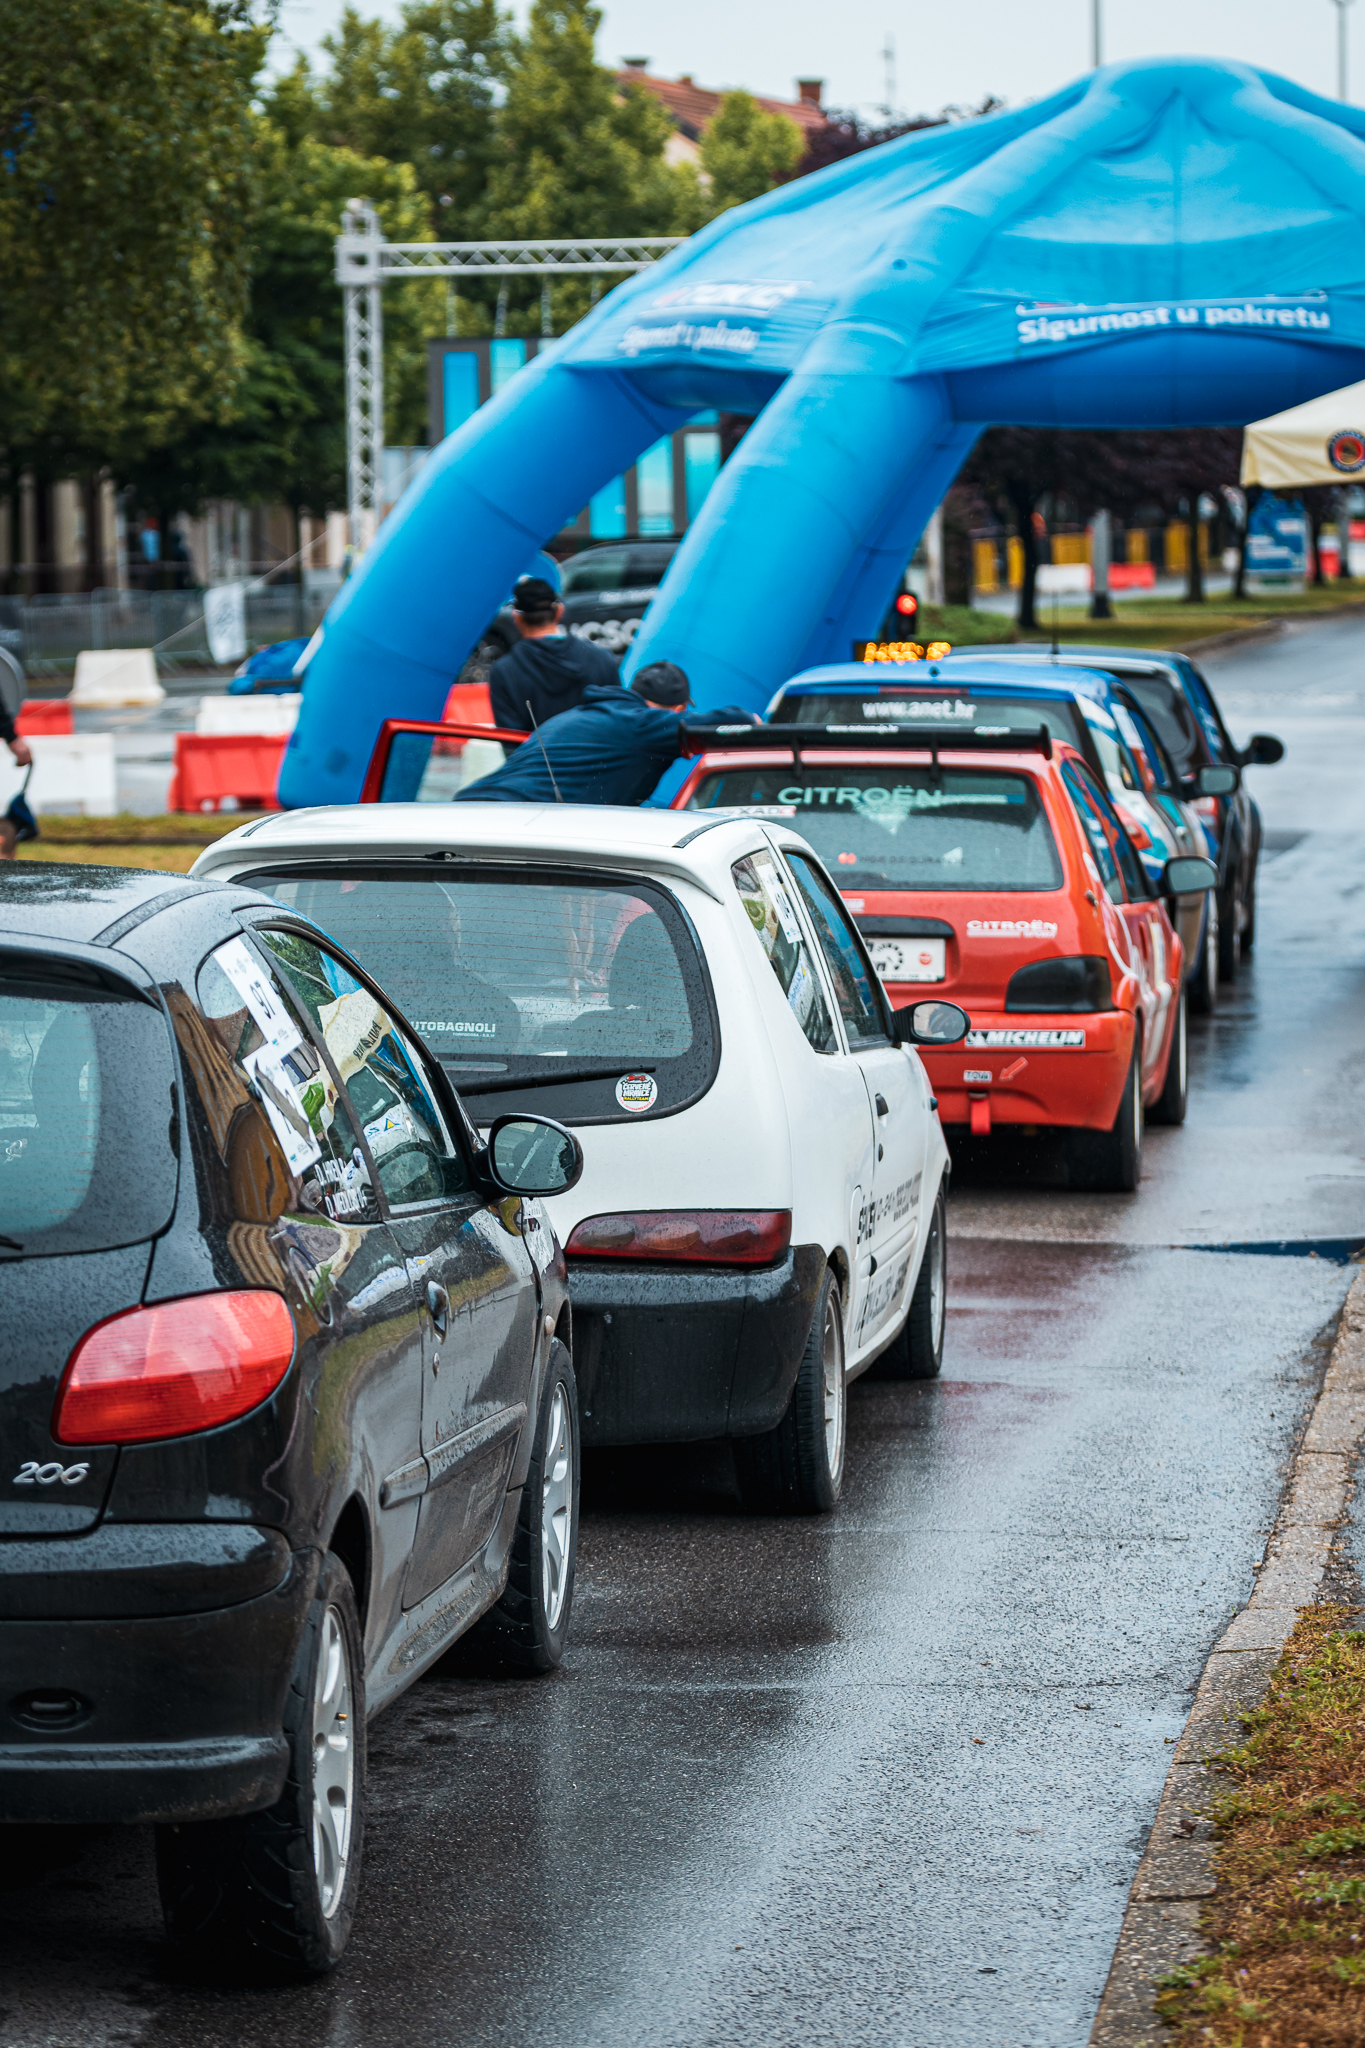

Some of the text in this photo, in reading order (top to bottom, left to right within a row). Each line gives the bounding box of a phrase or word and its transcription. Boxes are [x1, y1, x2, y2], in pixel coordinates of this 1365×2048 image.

[1017, 304, 1330, 343] Sigurnost u pokretu
[777, 785, 943, 807] CITROËN
[966, 919, 1058, 932] CITROËN
[410, 1021, 496, 1033] UTOBAGNOLI
[986, 1030, 1084, 1045] MICHELIN
[12, 1461, 91, 1485] 206
